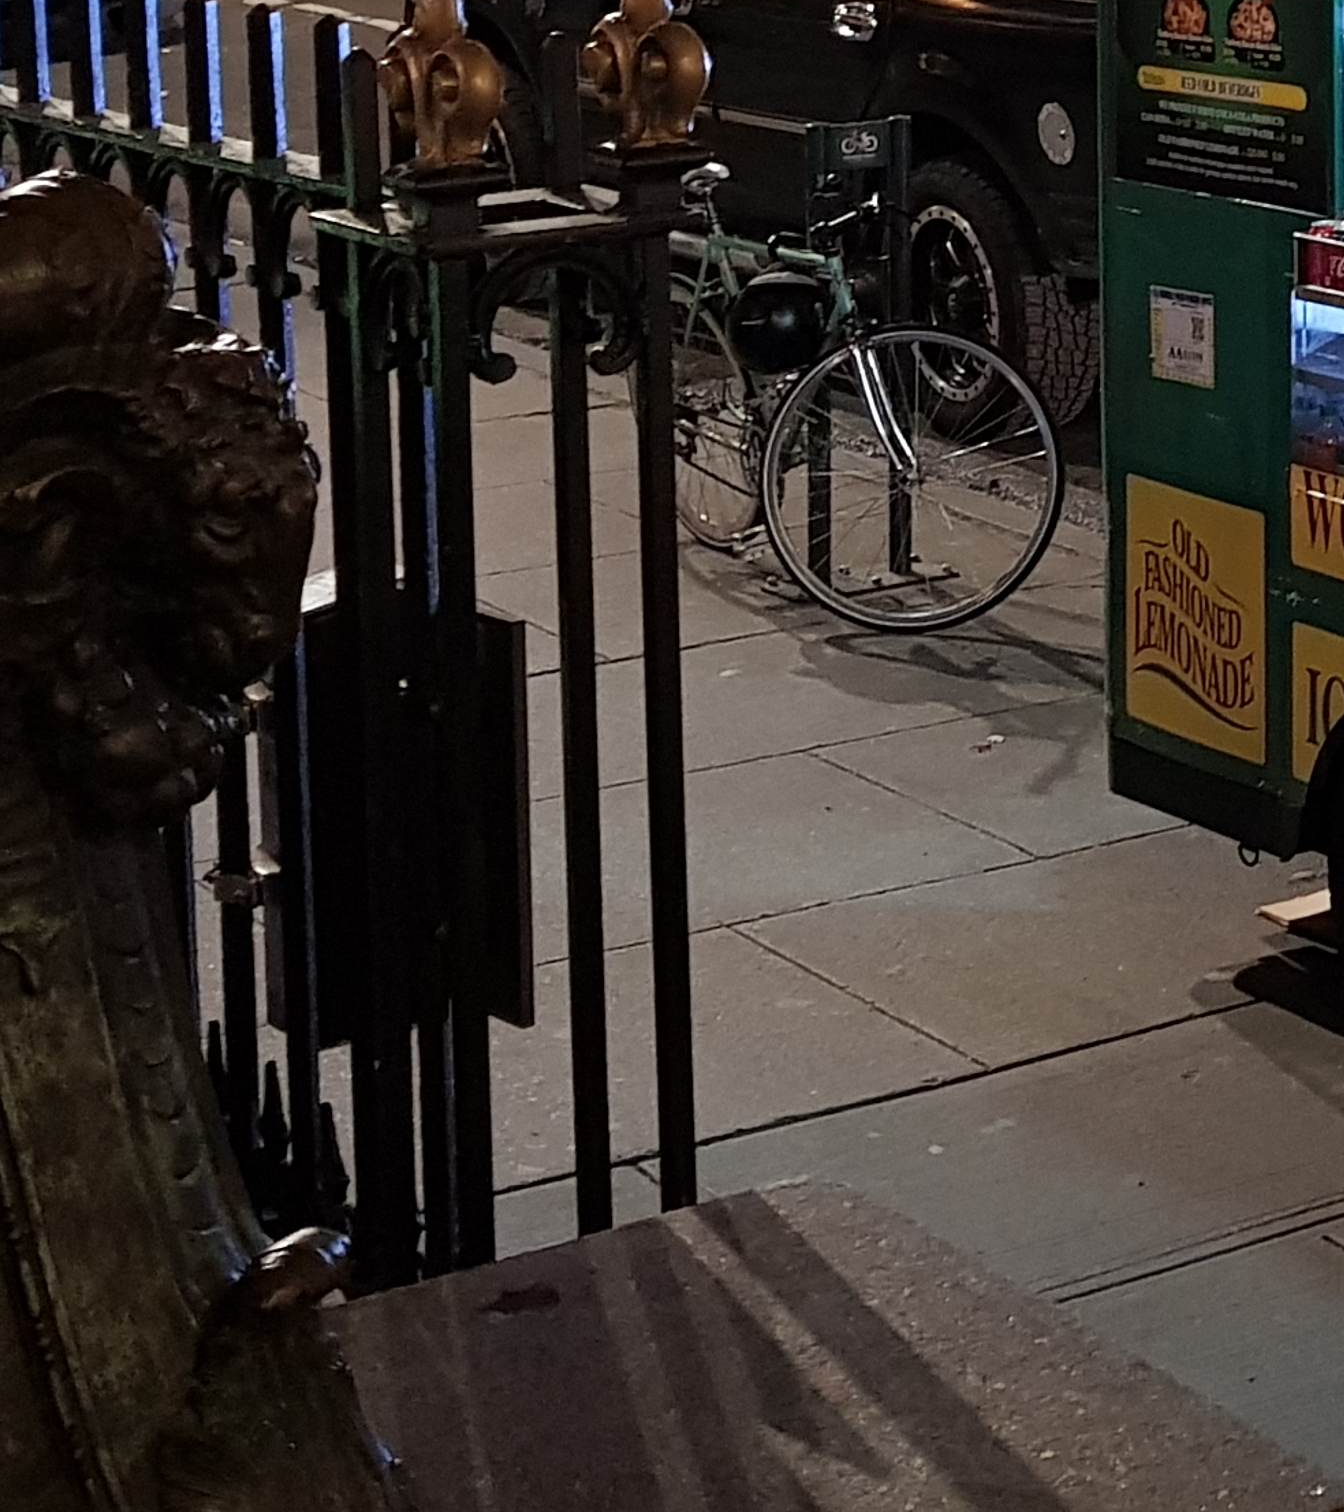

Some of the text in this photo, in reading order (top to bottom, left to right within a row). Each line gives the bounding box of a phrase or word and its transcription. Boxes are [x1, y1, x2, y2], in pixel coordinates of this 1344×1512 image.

[1145, 550, 1242, 650] FASHIONED
[1172, 519, 1210, 582] OLD
[1134, 587, 1255, 709] LEMONADE
